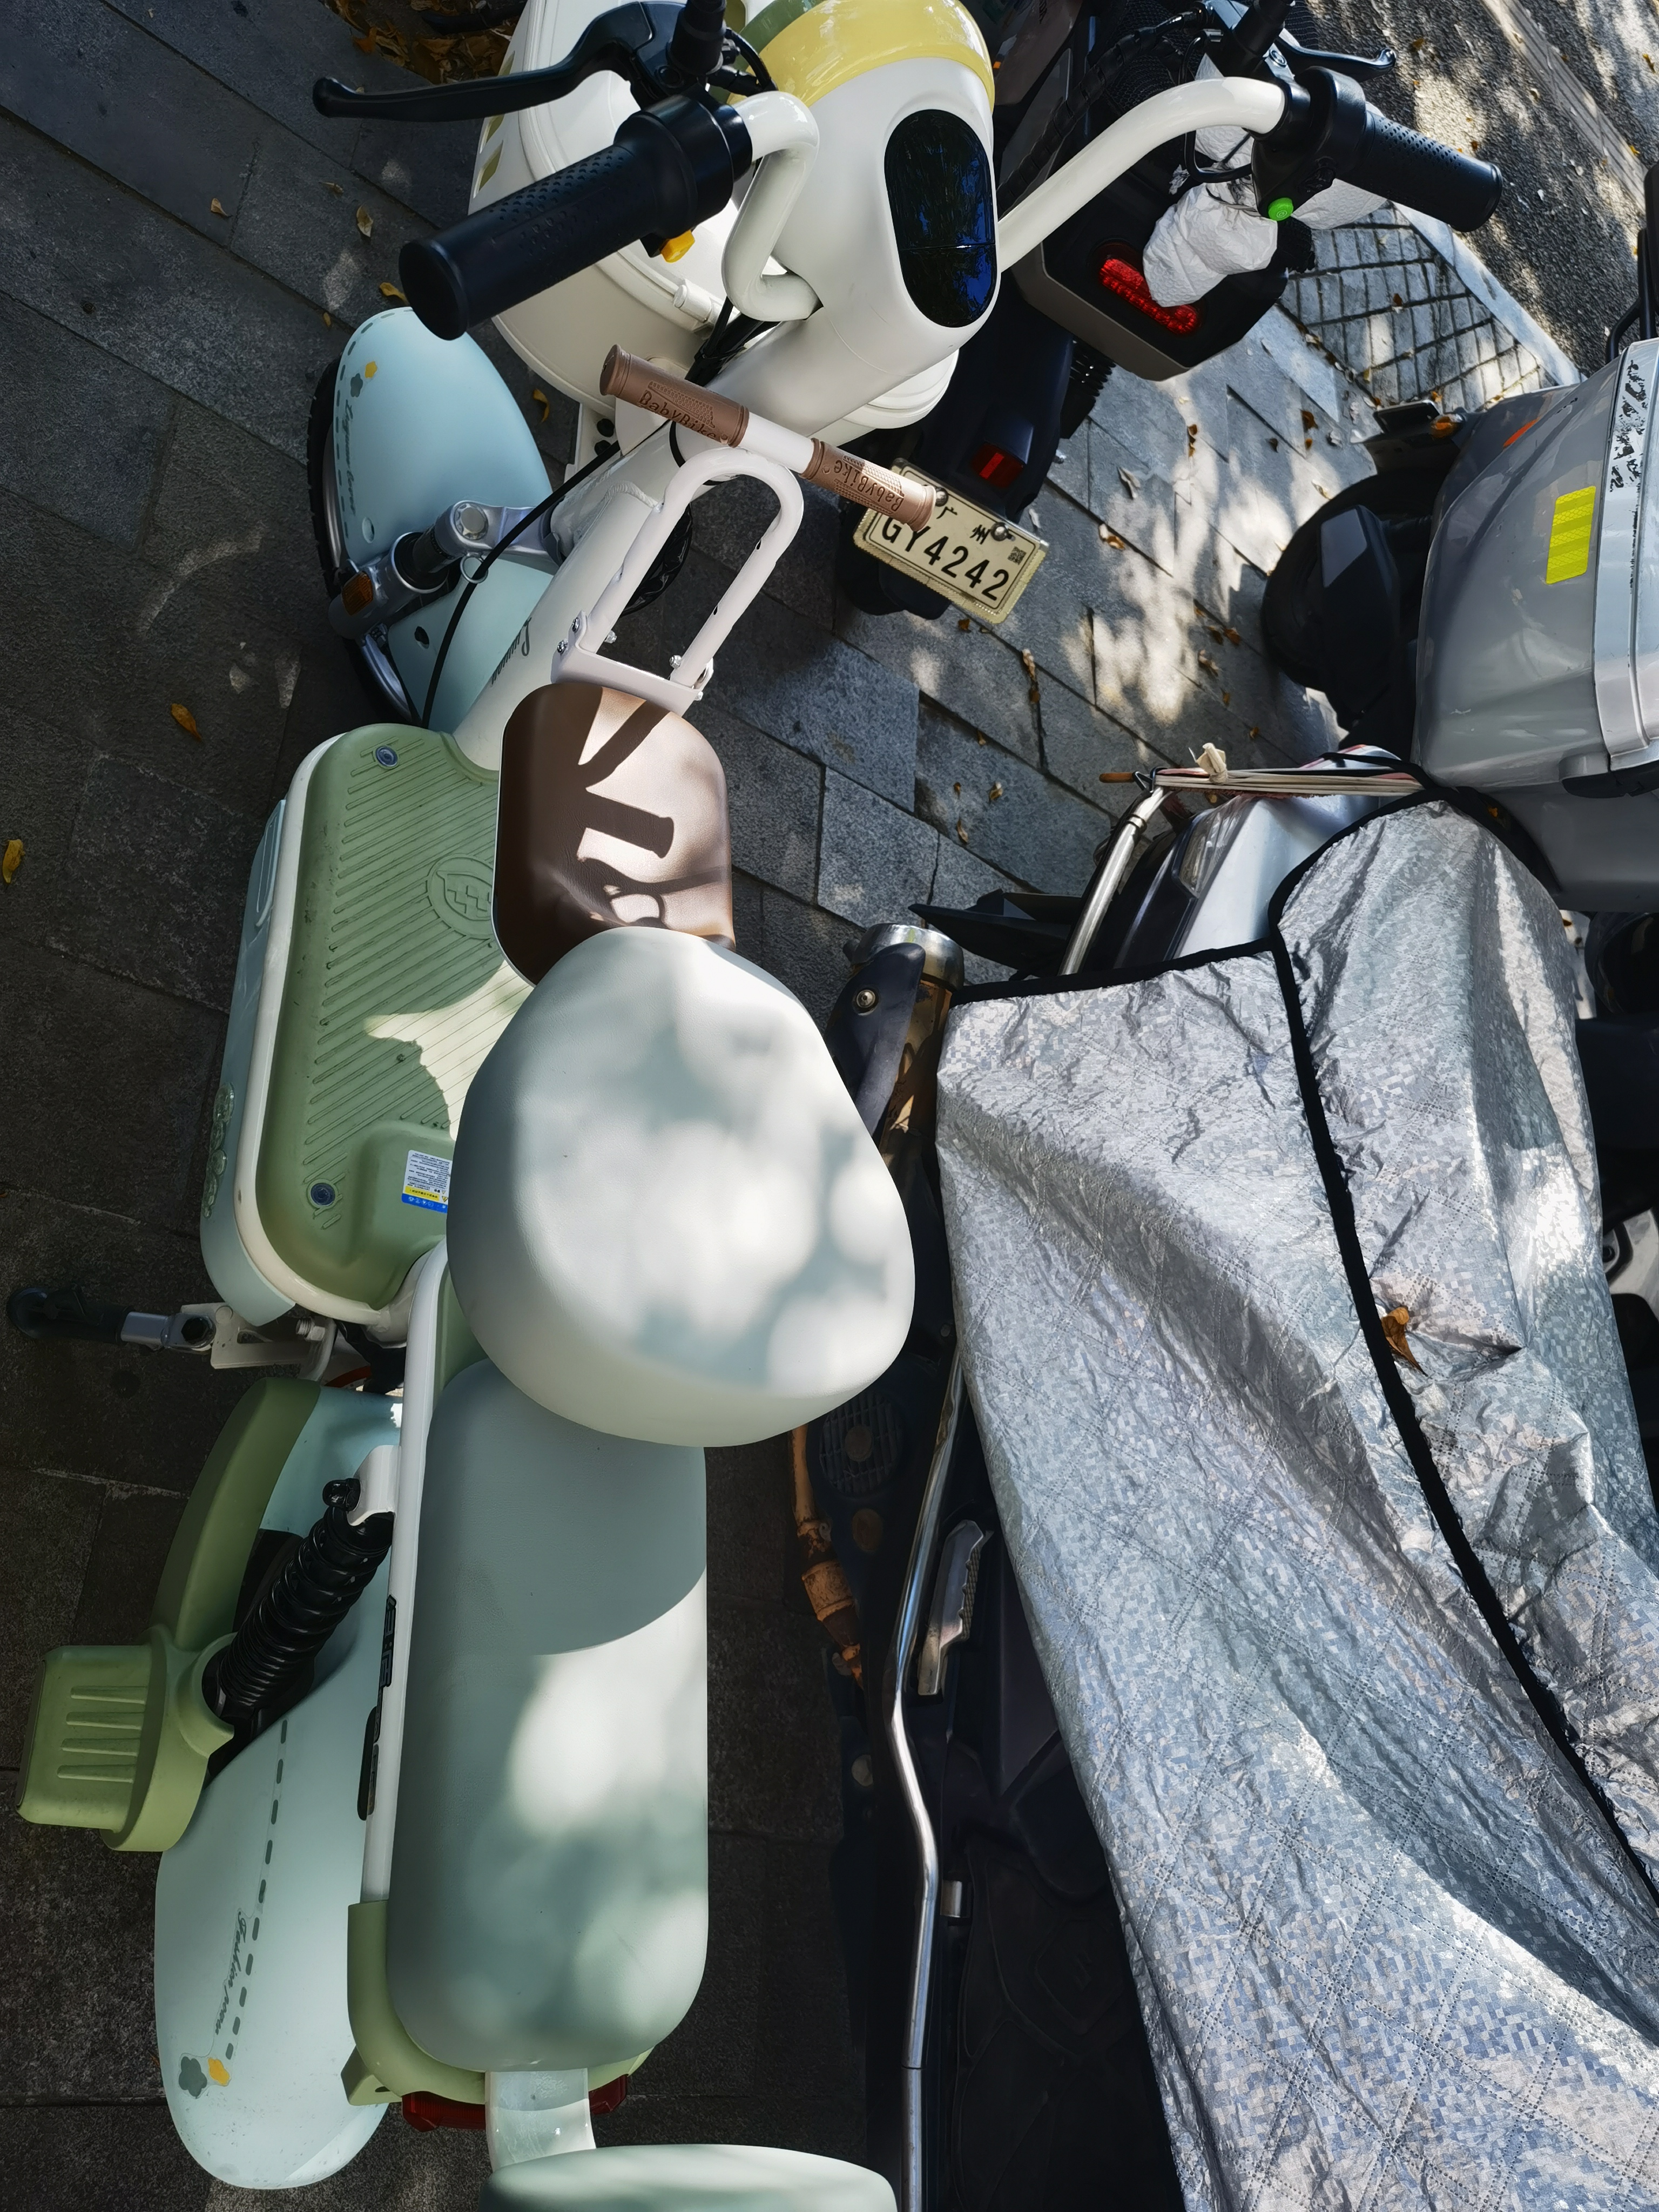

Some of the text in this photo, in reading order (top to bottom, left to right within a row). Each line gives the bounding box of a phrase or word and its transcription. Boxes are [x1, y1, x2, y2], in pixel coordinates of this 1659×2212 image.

[638, 389, 716, 439] BabyBike
[833, 460, 904, 512] BabyBike
[882, 517, 1009, 601] GY4242
[228, 1911, 247, 1988] Fashion
